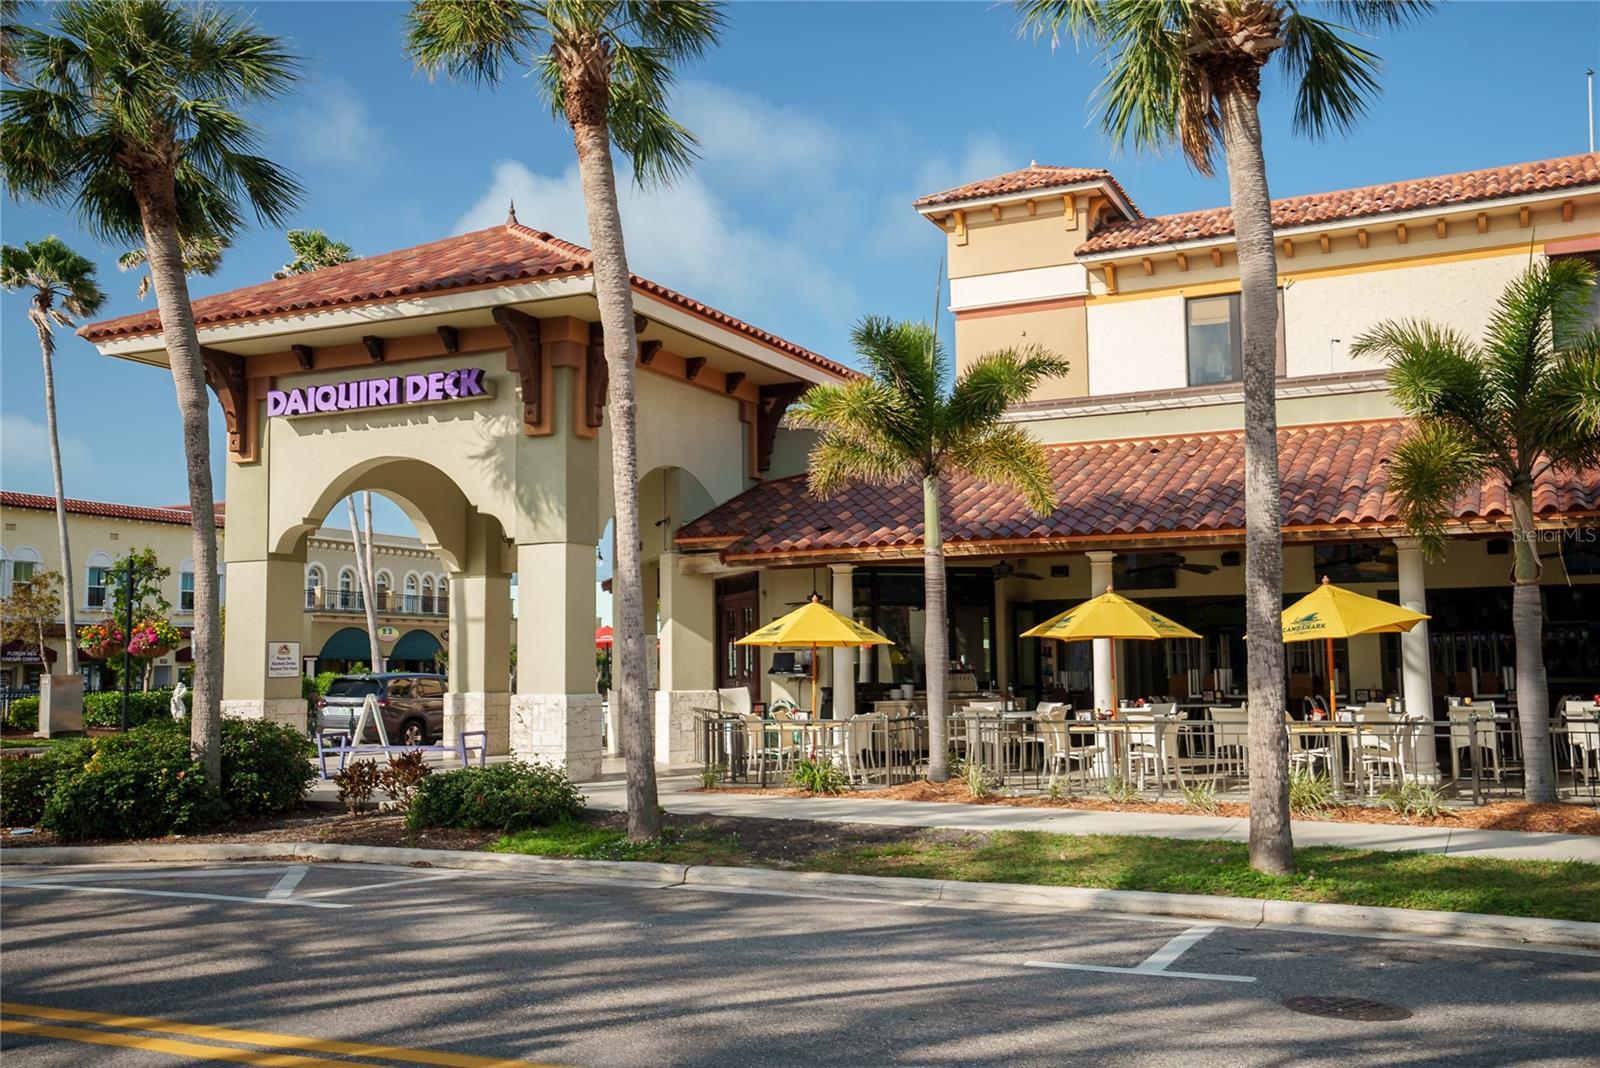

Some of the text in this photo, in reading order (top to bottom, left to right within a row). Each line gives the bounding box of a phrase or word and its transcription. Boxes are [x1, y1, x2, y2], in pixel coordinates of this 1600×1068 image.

[267, 367, 485, 417] DAIQUIRI DECK
[1283, 623, 1327, 633] LANDSHARK
